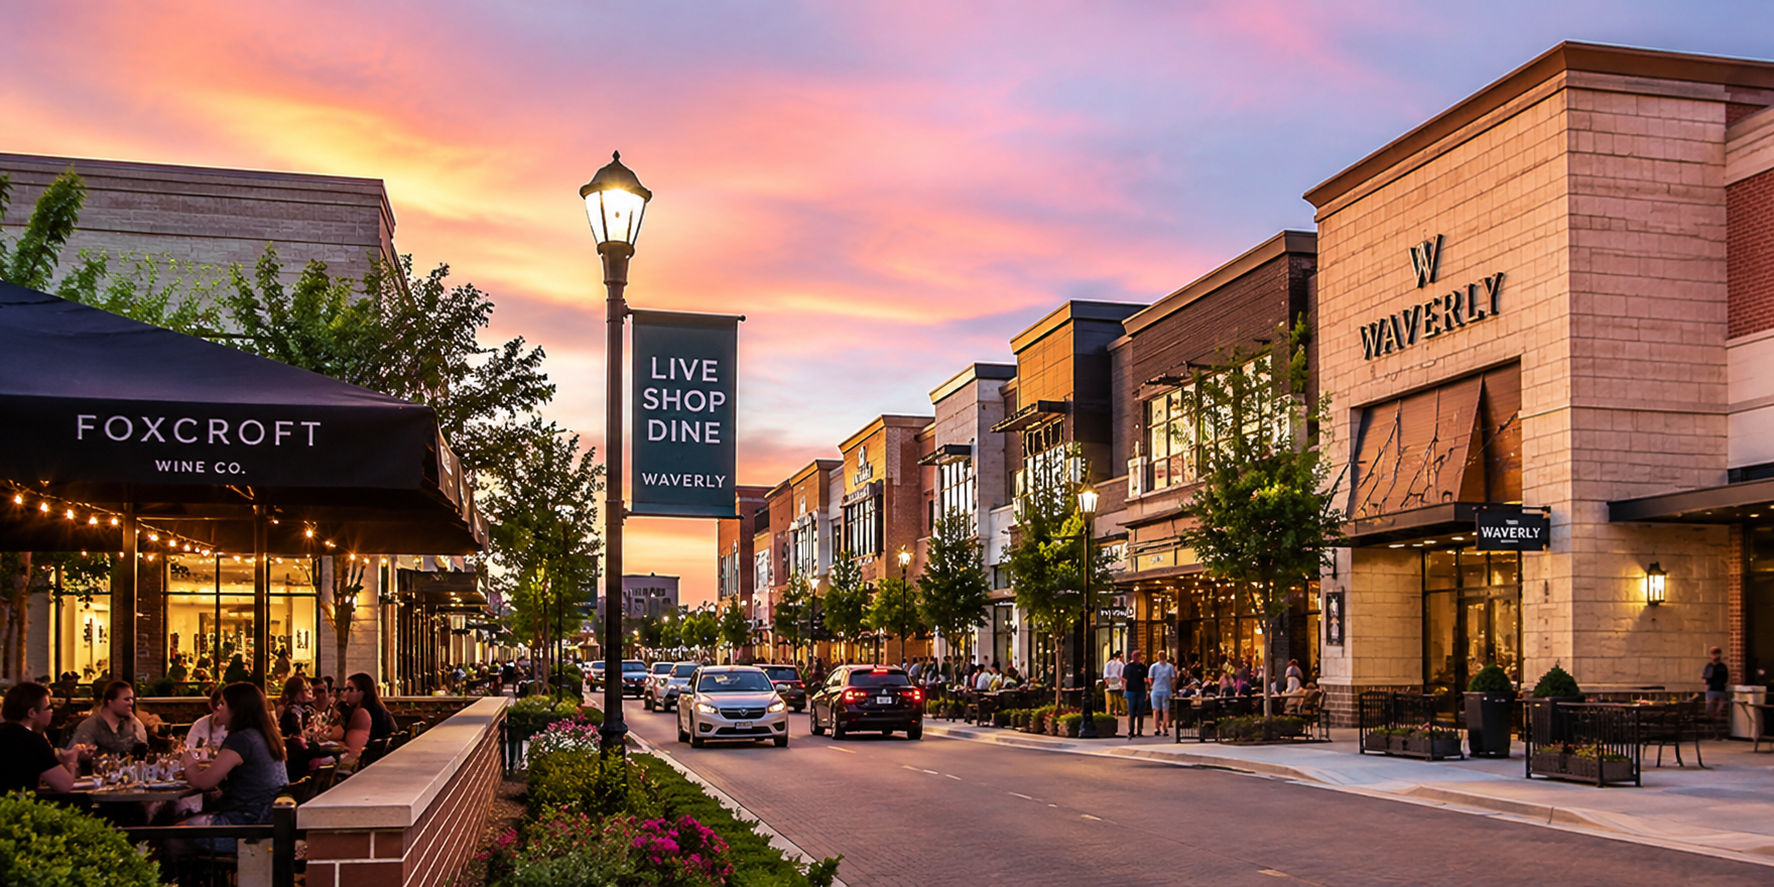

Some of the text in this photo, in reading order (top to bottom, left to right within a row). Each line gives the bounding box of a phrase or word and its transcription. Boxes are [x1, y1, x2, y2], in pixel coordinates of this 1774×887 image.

[1408, 233, 1445, 288] W
[1360, 272, 1505, 360] WAVERLY
[651, 356, 718, 382] LIVE
[642, 387, 726, 413] SHOP
[76, 414, 321, 447] FOXCROFT
[647, 419, 721, 444] DINE
[155, 459, 246, 475] WINE CO.
[641, 472, 726, 489] WAVERLY
[1480, 526, 1541, 539] WAVERLY
